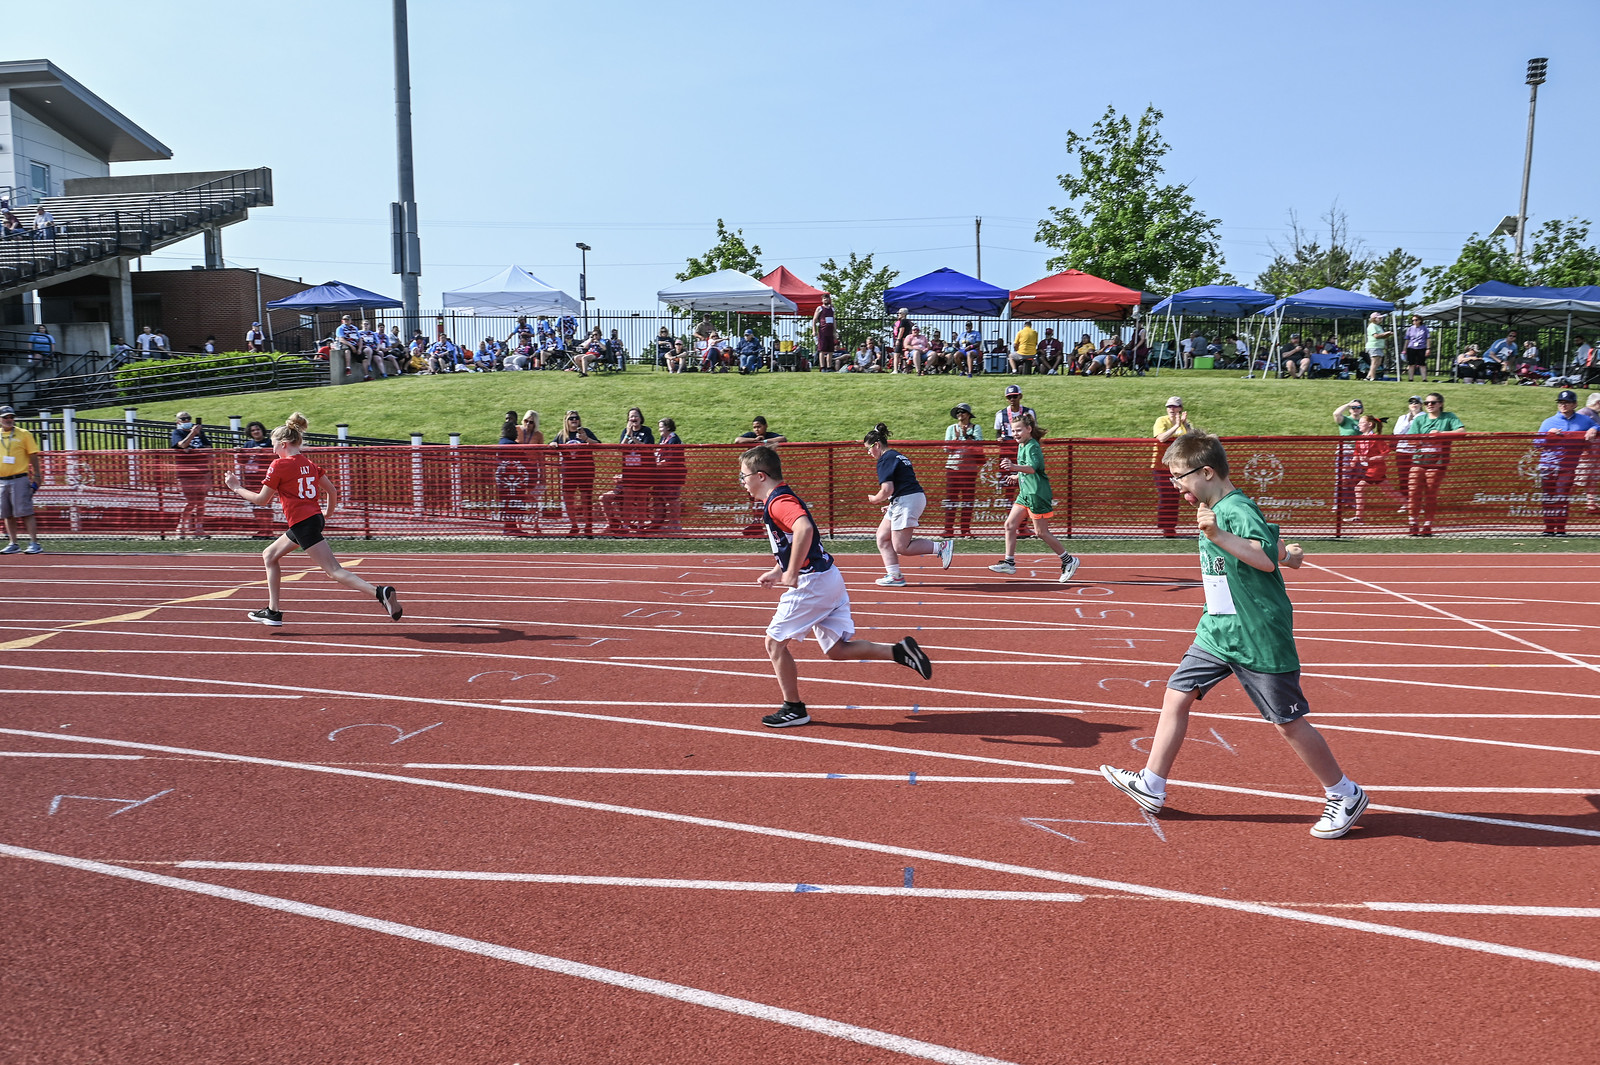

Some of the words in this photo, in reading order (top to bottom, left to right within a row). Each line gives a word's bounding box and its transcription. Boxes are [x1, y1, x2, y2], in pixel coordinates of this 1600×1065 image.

[297, 476, 317, 499] 15
[701, 501, 751, 512] Special
[940, 498, 991, 510] Special
[1257, 496, 1326, 508] Olympics
[657, 589, 715, 597] 6
[622, 607, 683, 618] 5
[1075, 607, 1136, 619] 5
[466, 670, 560, 686] 3
[327, 721, 444, 745] 2
